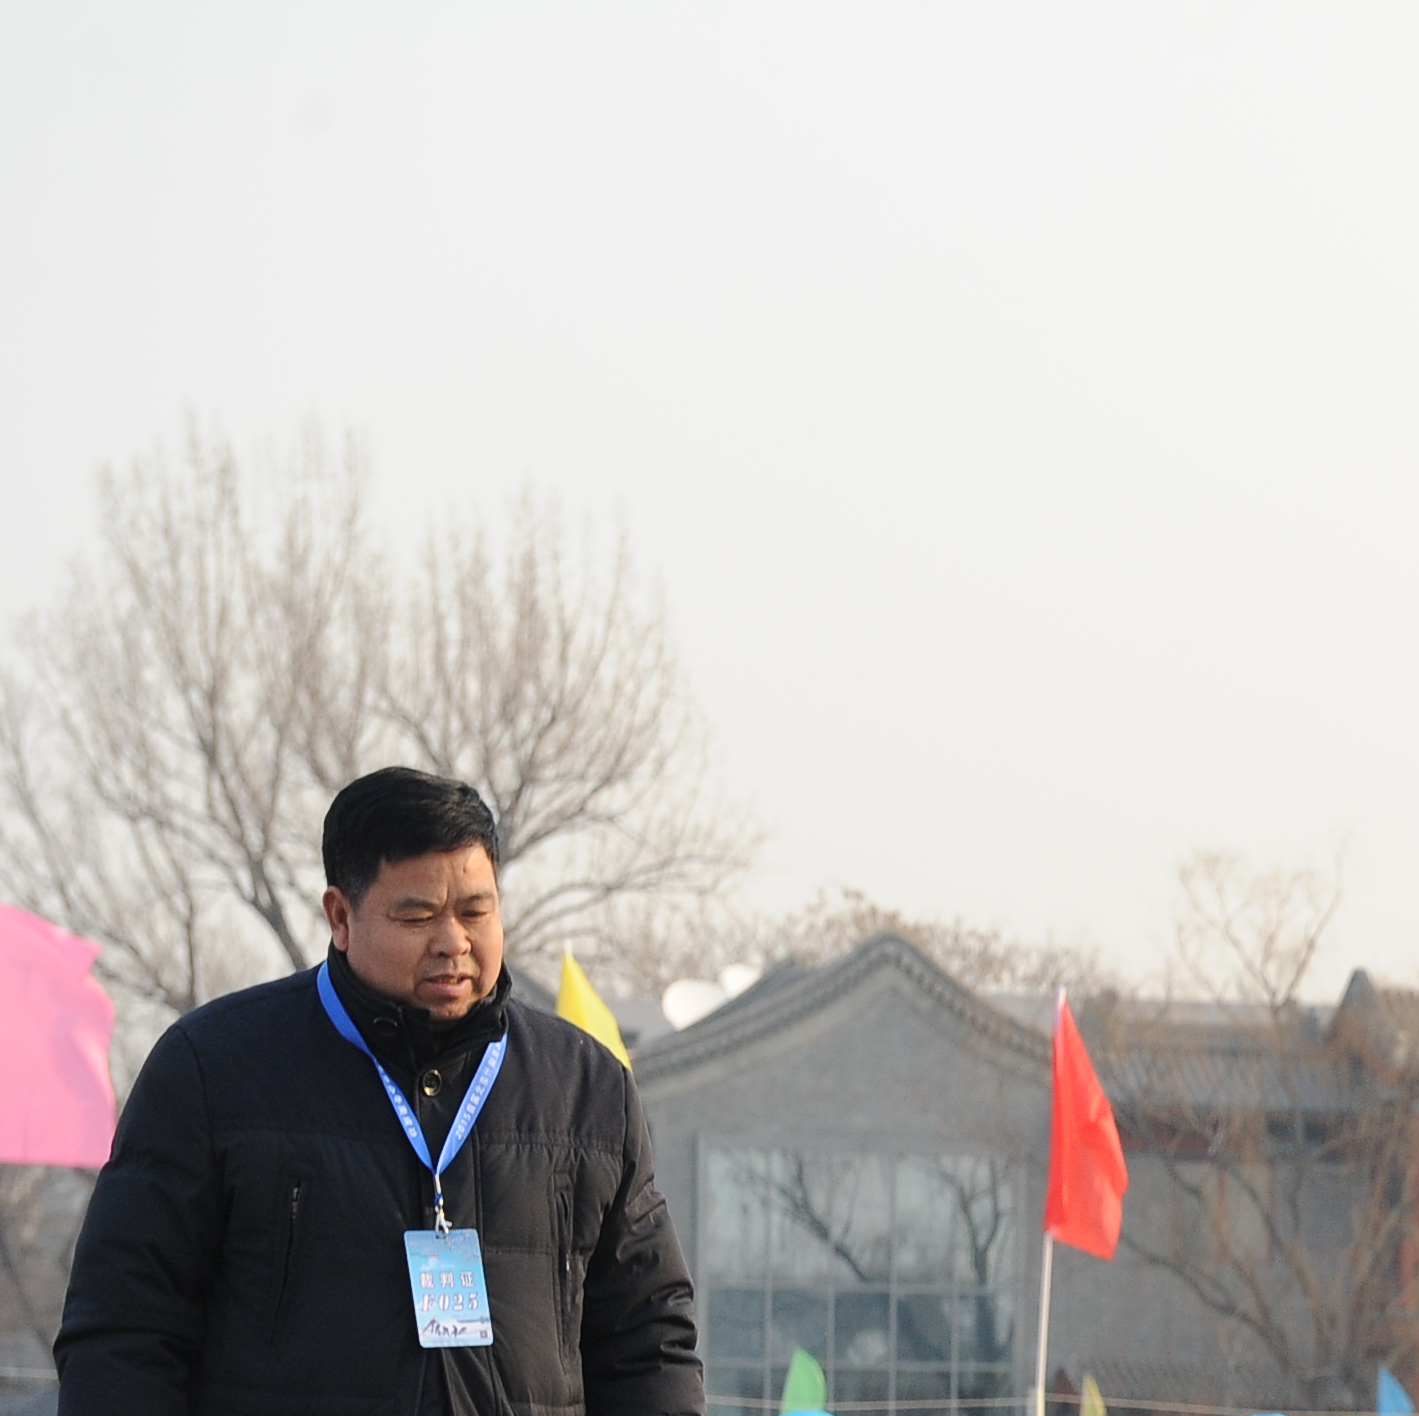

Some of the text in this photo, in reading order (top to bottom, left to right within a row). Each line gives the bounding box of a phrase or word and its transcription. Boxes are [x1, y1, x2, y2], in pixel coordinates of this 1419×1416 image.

[420, 1271, 475, 1289] 裁判证
[422, 1293, 479, 1312] F025
